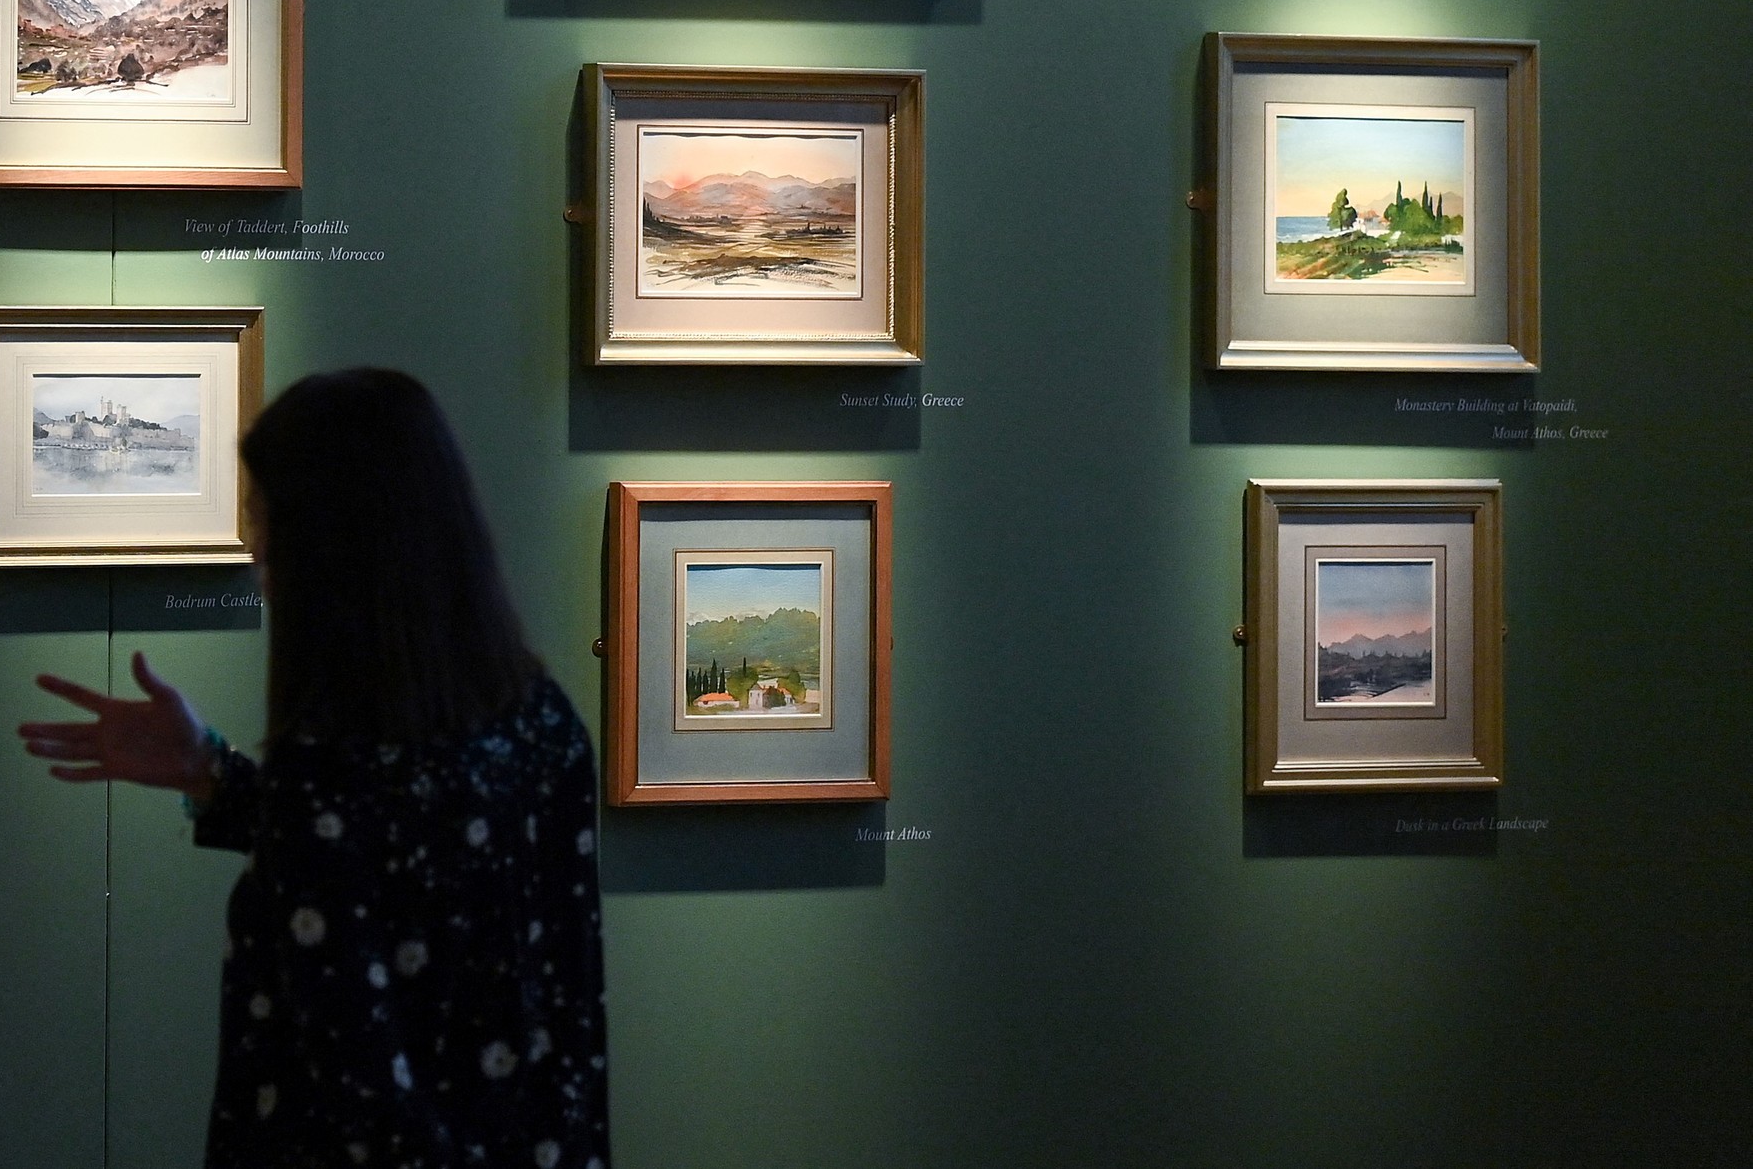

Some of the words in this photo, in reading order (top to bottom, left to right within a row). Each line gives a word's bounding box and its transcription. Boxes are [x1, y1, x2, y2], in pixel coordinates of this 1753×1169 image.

[184, 218, 215, 233] View
[217, 219, 234, 237] of
[237, 219, 288, 235] Taddert,
[292, 219, 350, 235] Foothills
[200, 246, 218, 263] of
[217, 247, 250, 261] Atlas
[252, 247, 325, 263] Mountains,
[328, 247, 385, 261] Morocco
[840, 393, 879, 407] Sunset
[882, 393, 917, 409] Study,
[922, 393, 964, 407] Greece
[1395, 398, 1455, 414] Monastery
[1456, 398, 1505, 415] Building
[1508, 401, 1519, 412] at
[1492, 426, 1529, 439] Mount
[1569, 425, 1609, 439] Greece
[165, 594, 216, 609] Bodrum
[1452, 817, 1485, 831] Greek
[1488, 817, 1549, 832] Landscape
[855, 828, 896, 842] Mount
[896, 826, 932, 840] Athos
